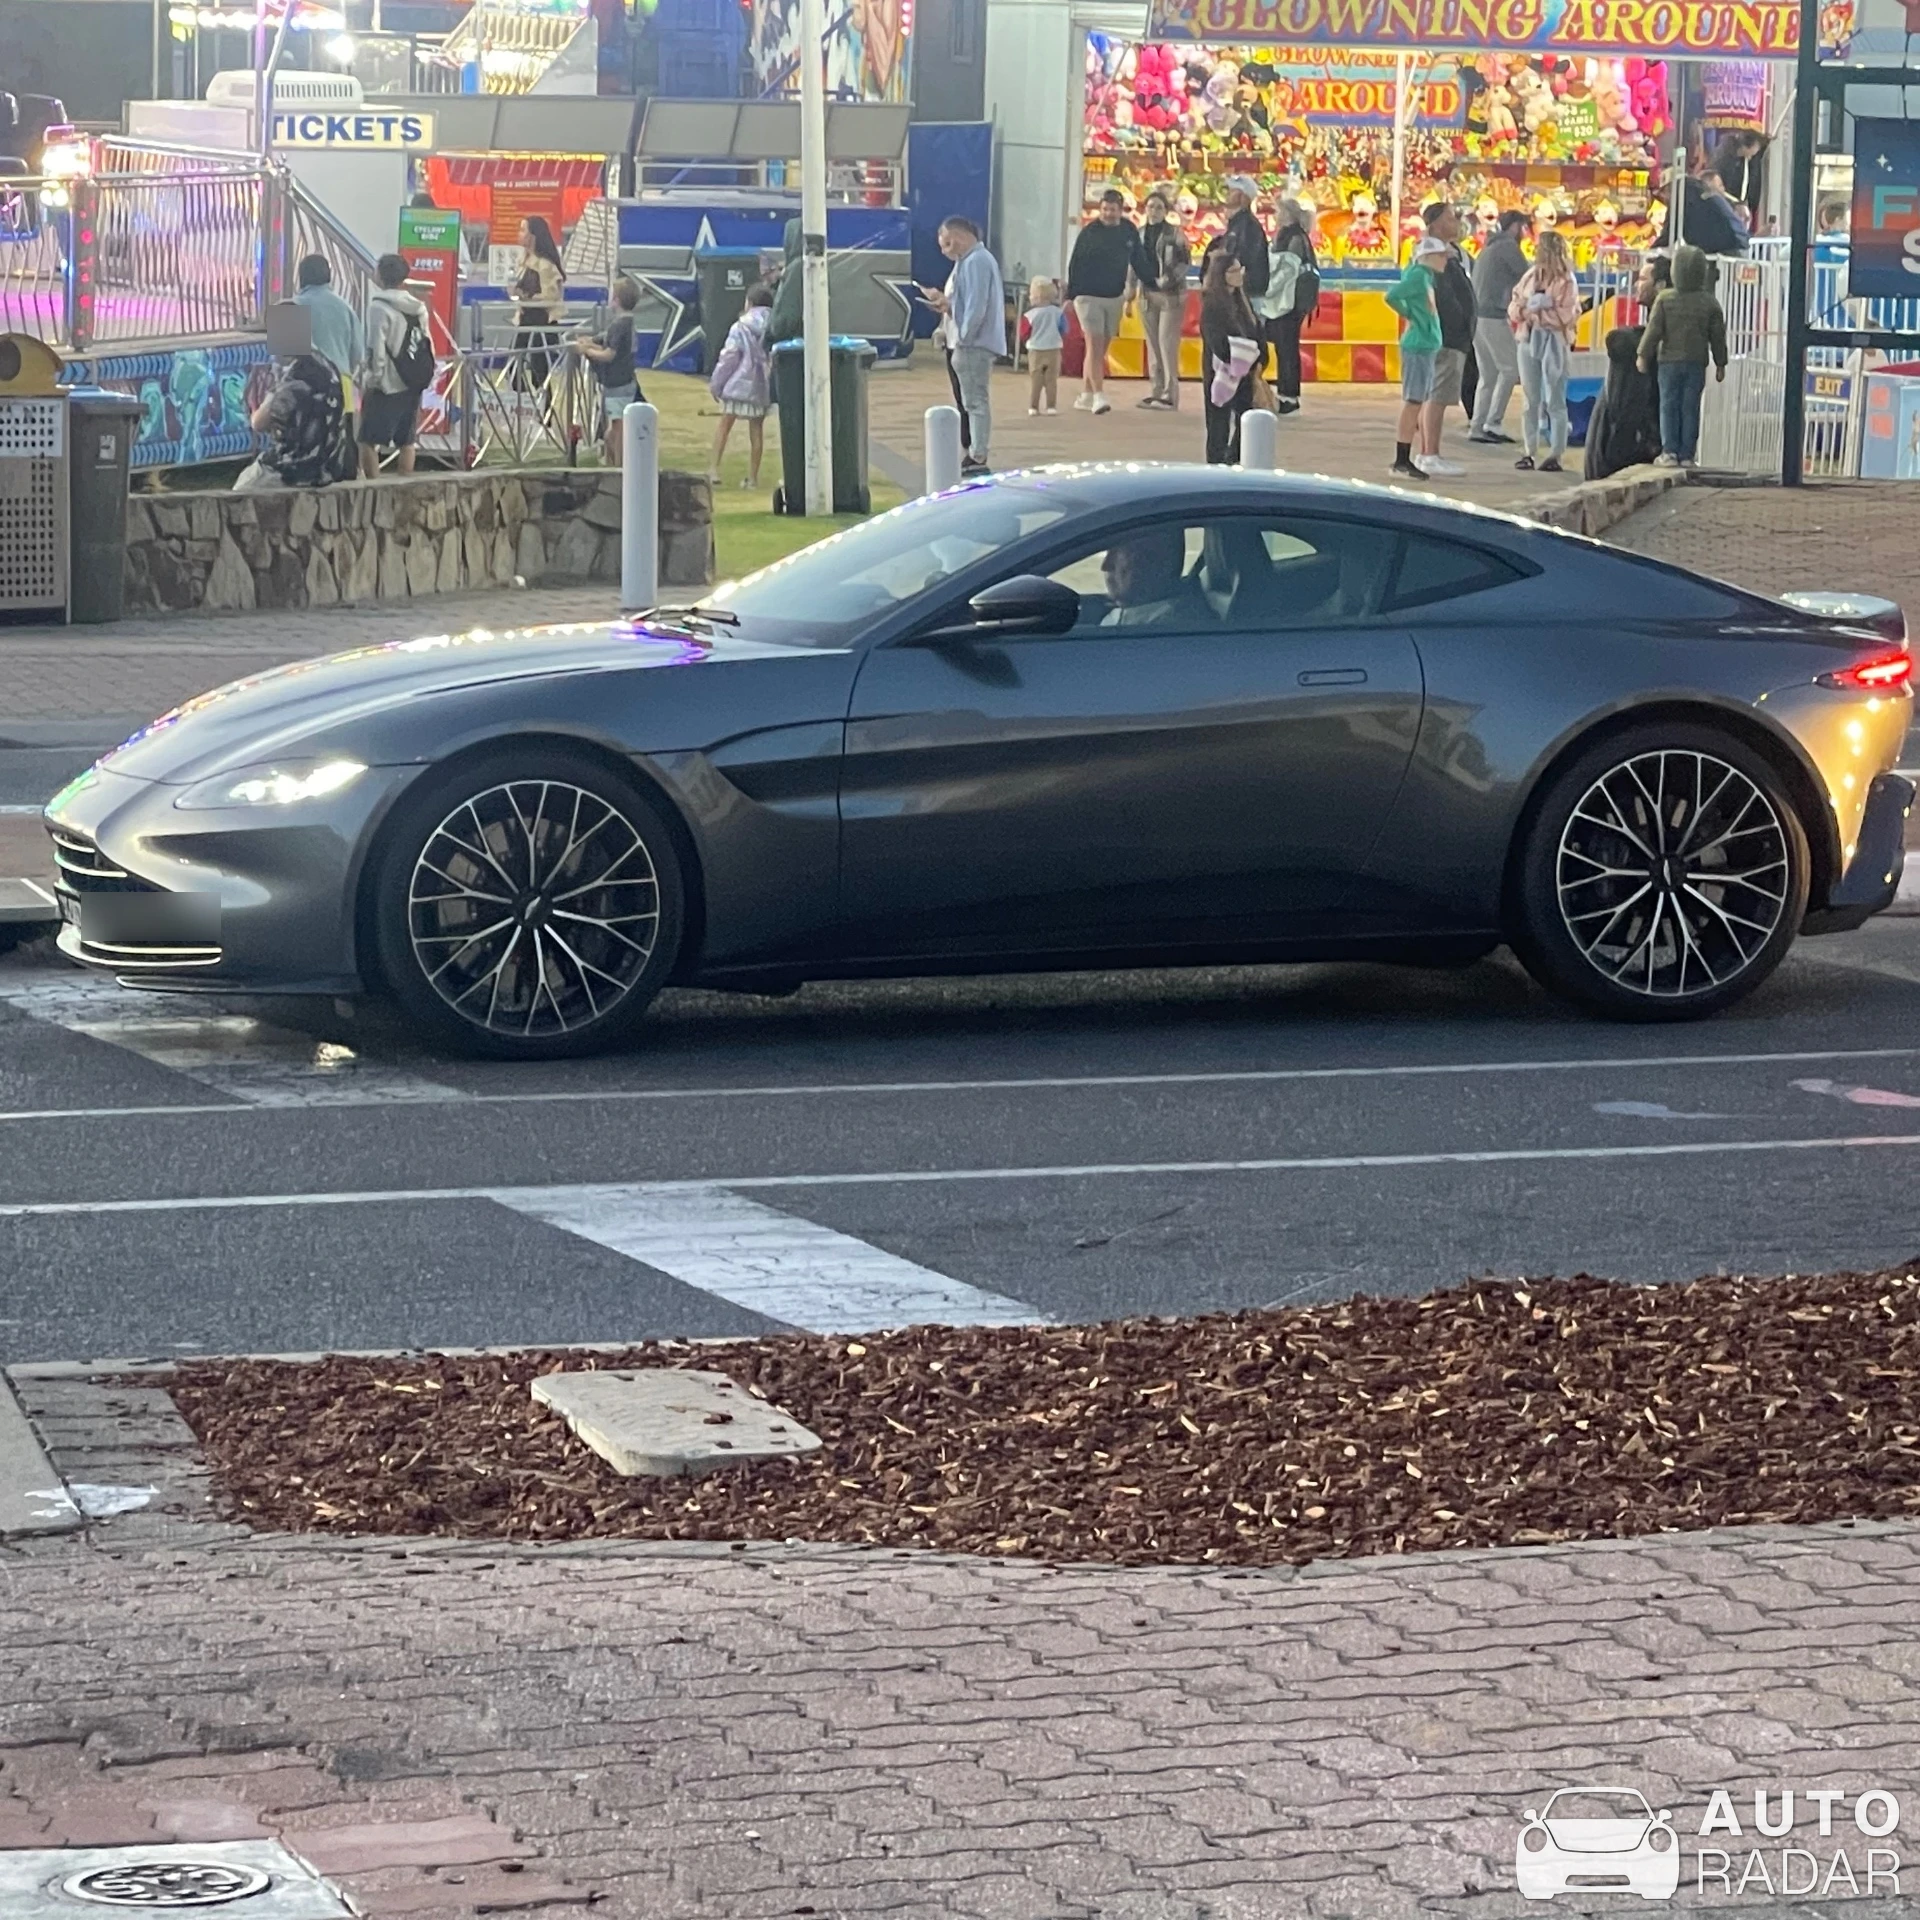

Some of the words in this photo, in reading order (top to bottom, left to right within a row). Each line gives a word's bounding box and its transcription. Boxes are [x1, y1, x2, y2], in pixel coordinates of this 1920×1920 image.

[1199, 0, 1538, 40] CLOWNING
[272, 115, 422, 142] TICKETS
[1574, 125, 1593, 138] $20
[1814, 377, 1845, 396] EXIT
